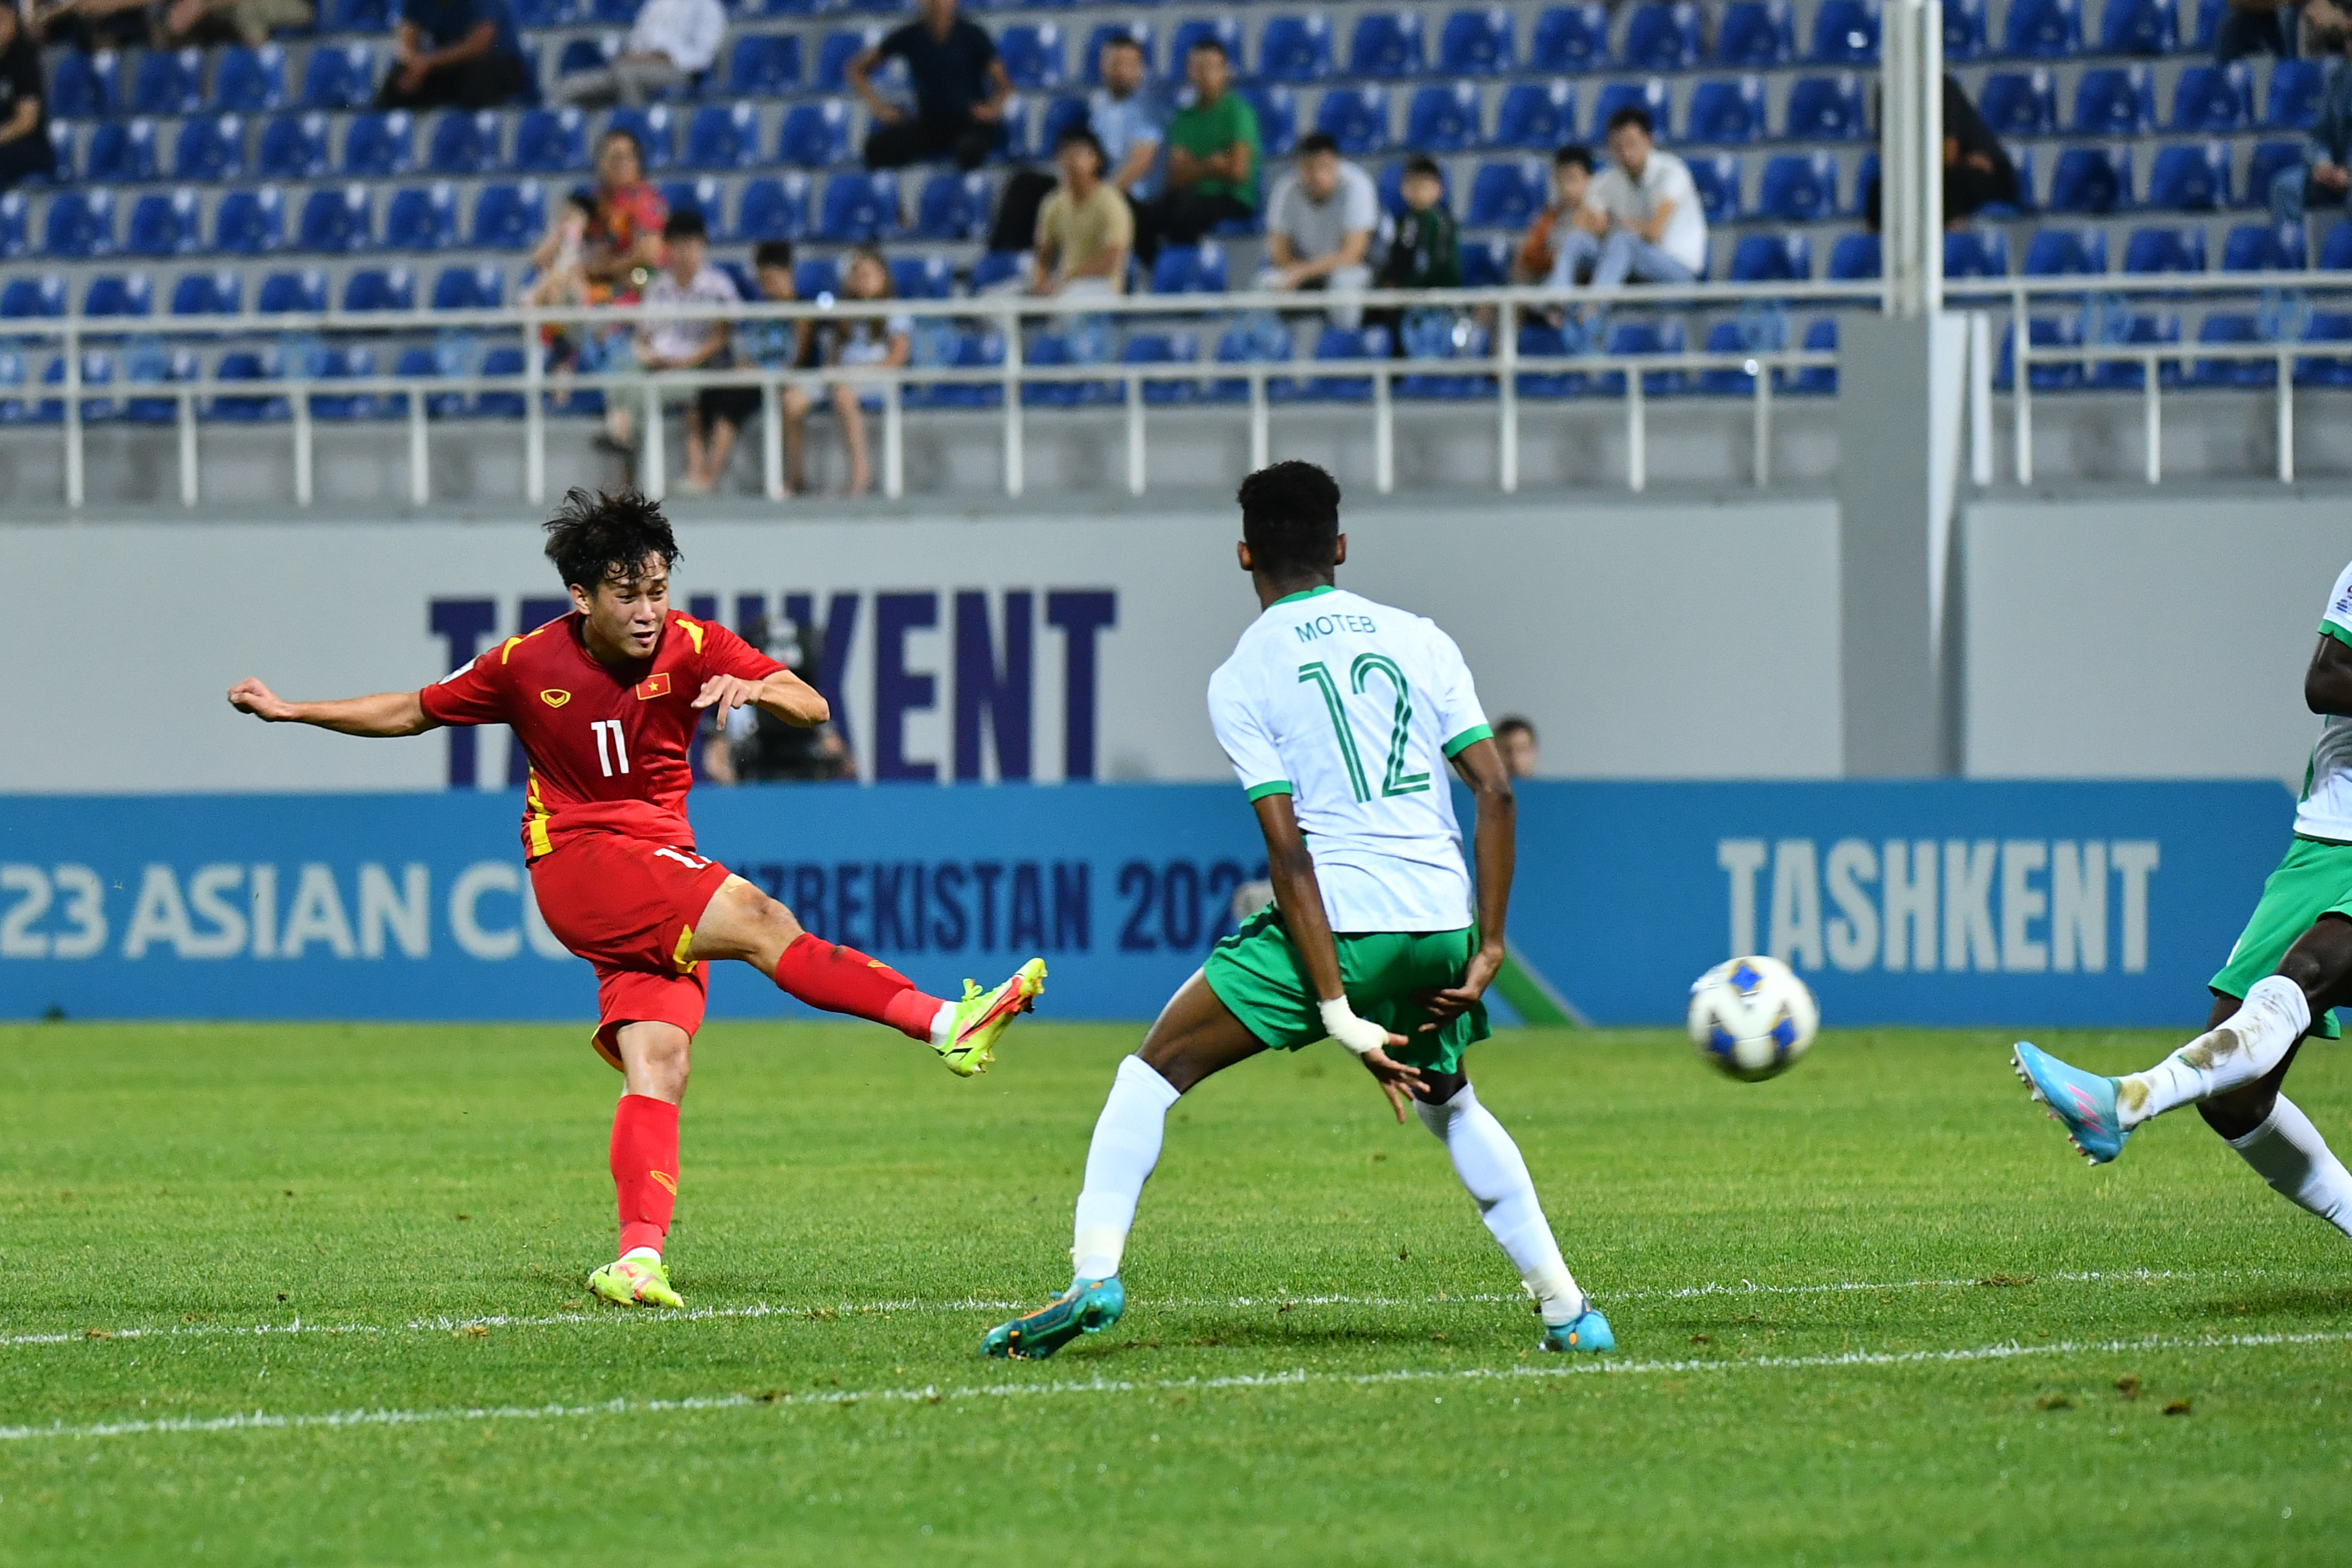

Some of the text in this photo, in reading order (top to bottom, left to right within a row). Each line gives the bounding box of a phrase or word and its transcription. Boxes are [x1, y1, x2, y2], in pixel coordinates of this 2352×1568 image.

[1295, 614, 1376, 642] MOTEB
[428, 589, 1116, 787] TKENT
[1299, 652, 1429, 803] 12
[591, 720, 630, 777] 11
[122, 863, 430, 959] ASIAN
[739, 861, 1270, 950] BEKISTAN 202
[1718, 840, 2159, 973] TASHKENT
